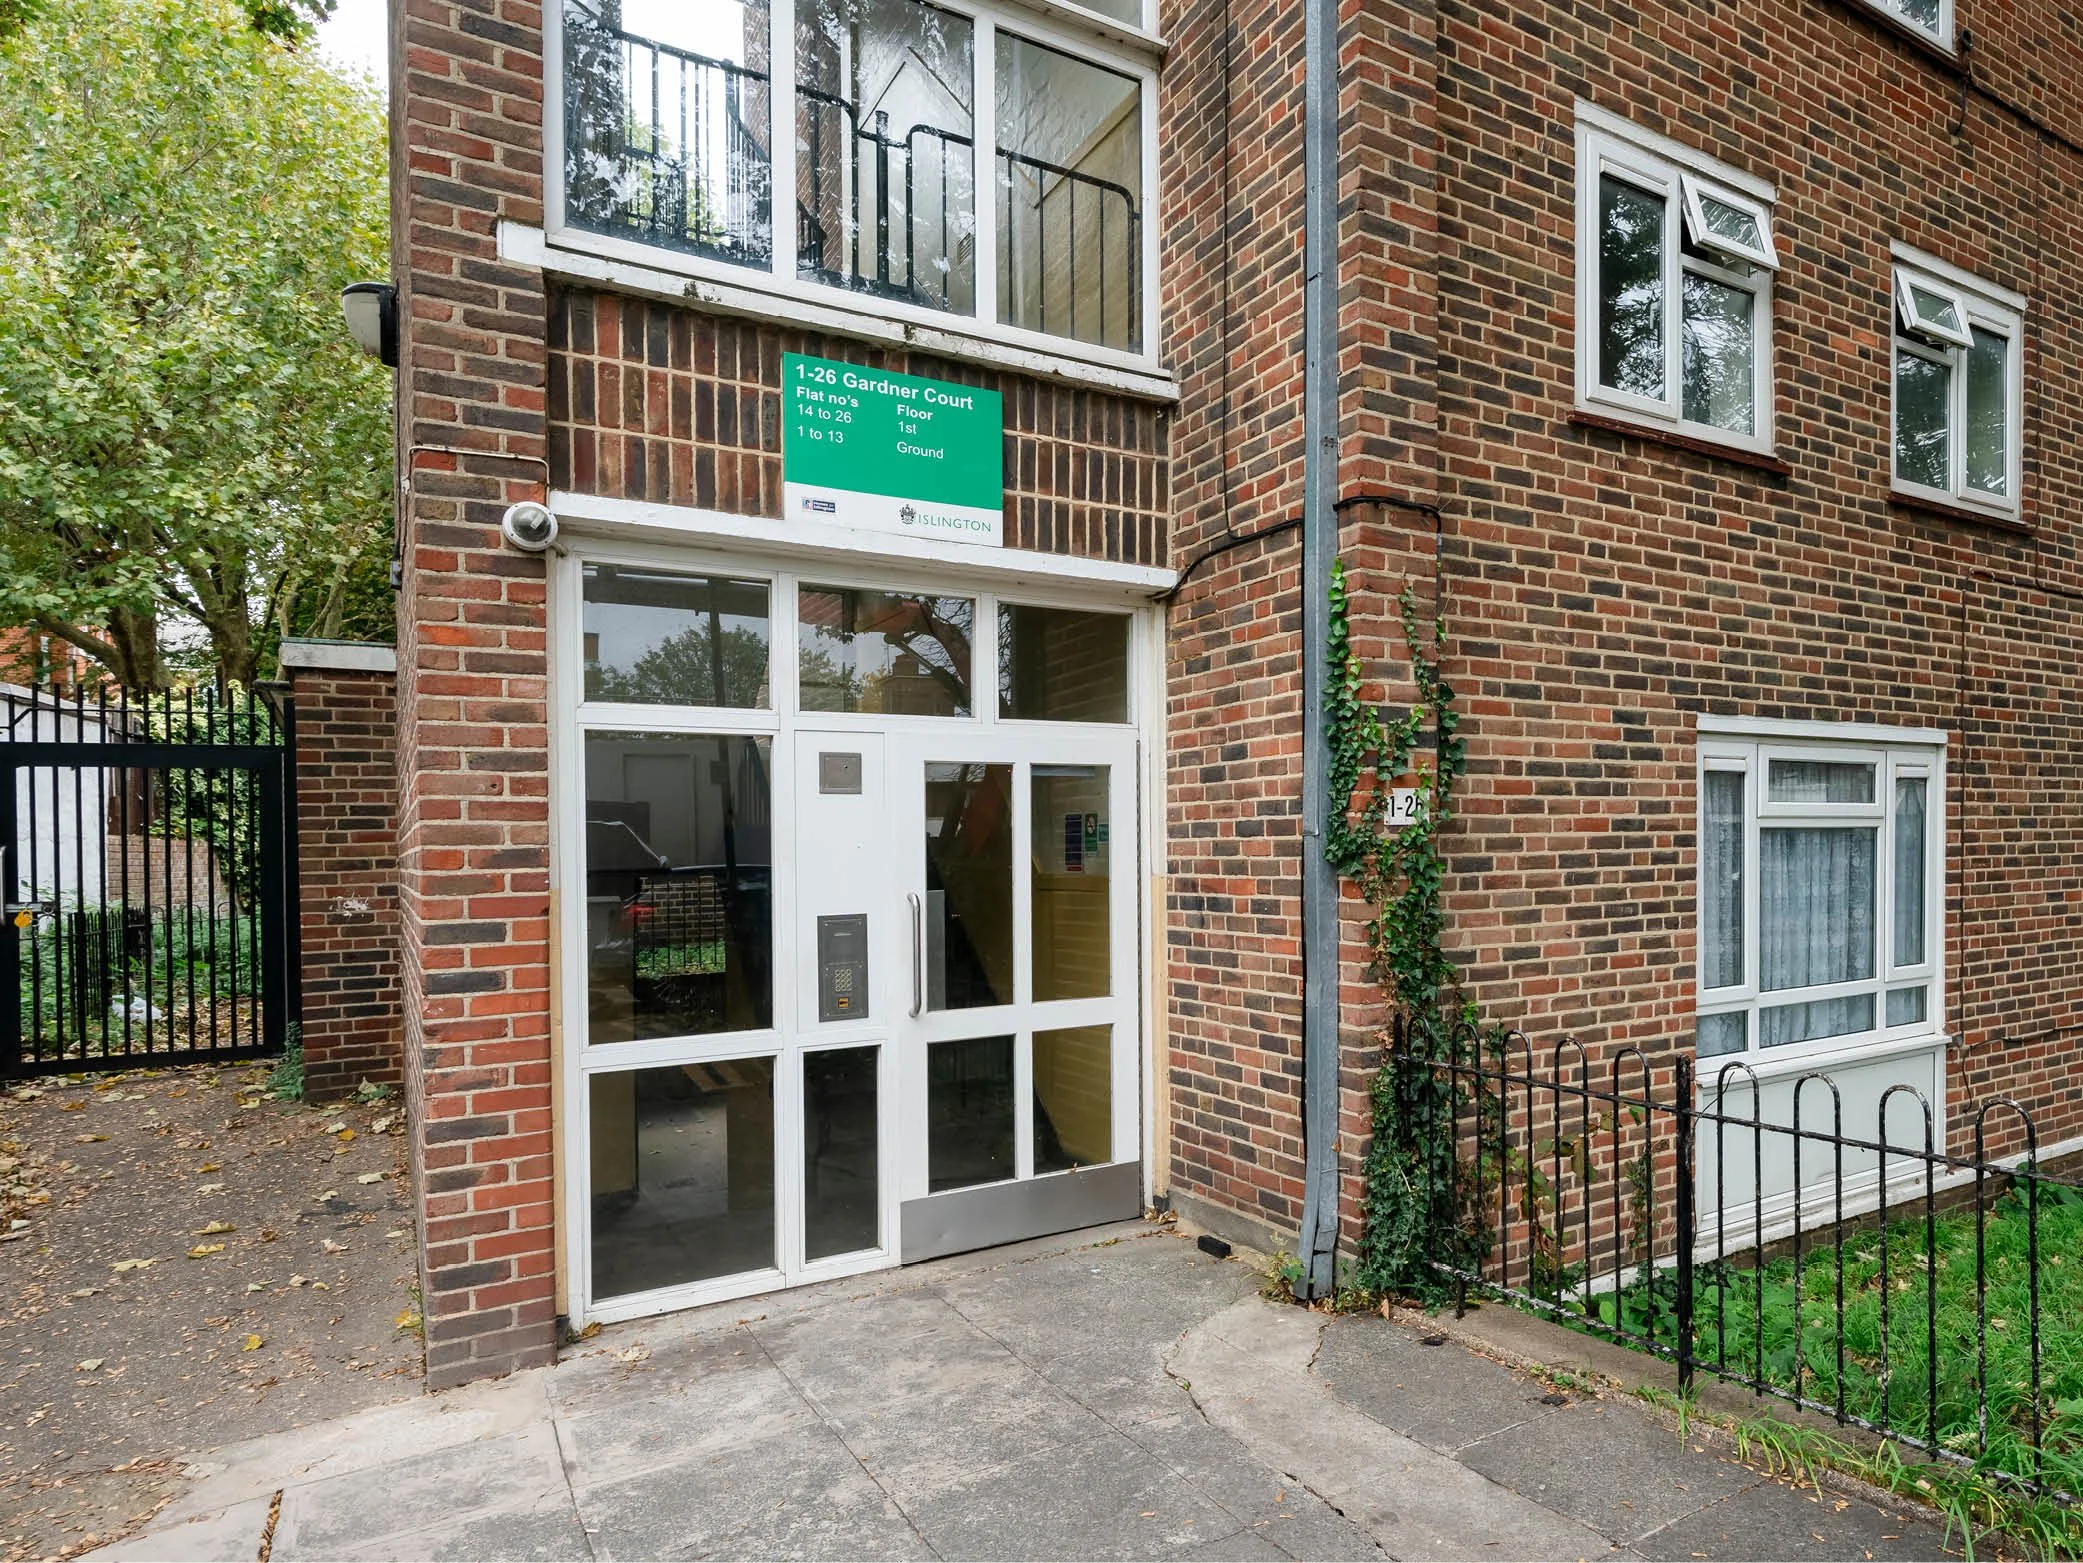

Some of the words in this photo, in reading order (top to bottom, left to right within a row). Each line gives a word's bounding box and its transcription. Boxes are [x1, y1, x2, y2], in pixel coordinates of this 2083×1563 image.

[796, 363, 836, 384] 1-26
[843, 372, 919, 399] Gardner
[924, 388, 974, 410] Court
[796, 386, 824, 402] Flat
[829, 394, 859, 408] no's
[797, 404, 813, 417] 14
[818, 408, 831, 419] to
[835, 410, 852, 423] 26
[897, 404, 933, 421] Floor
[797, 426, 804, 437] 1
[809, 427, 822, 440] to
[829, 430, 844, 443] 13
[898, 421, 916, 434] 1st
[897, 441, 943, 459] Ground
[918, 514, 991, 532] ISLINGTON
